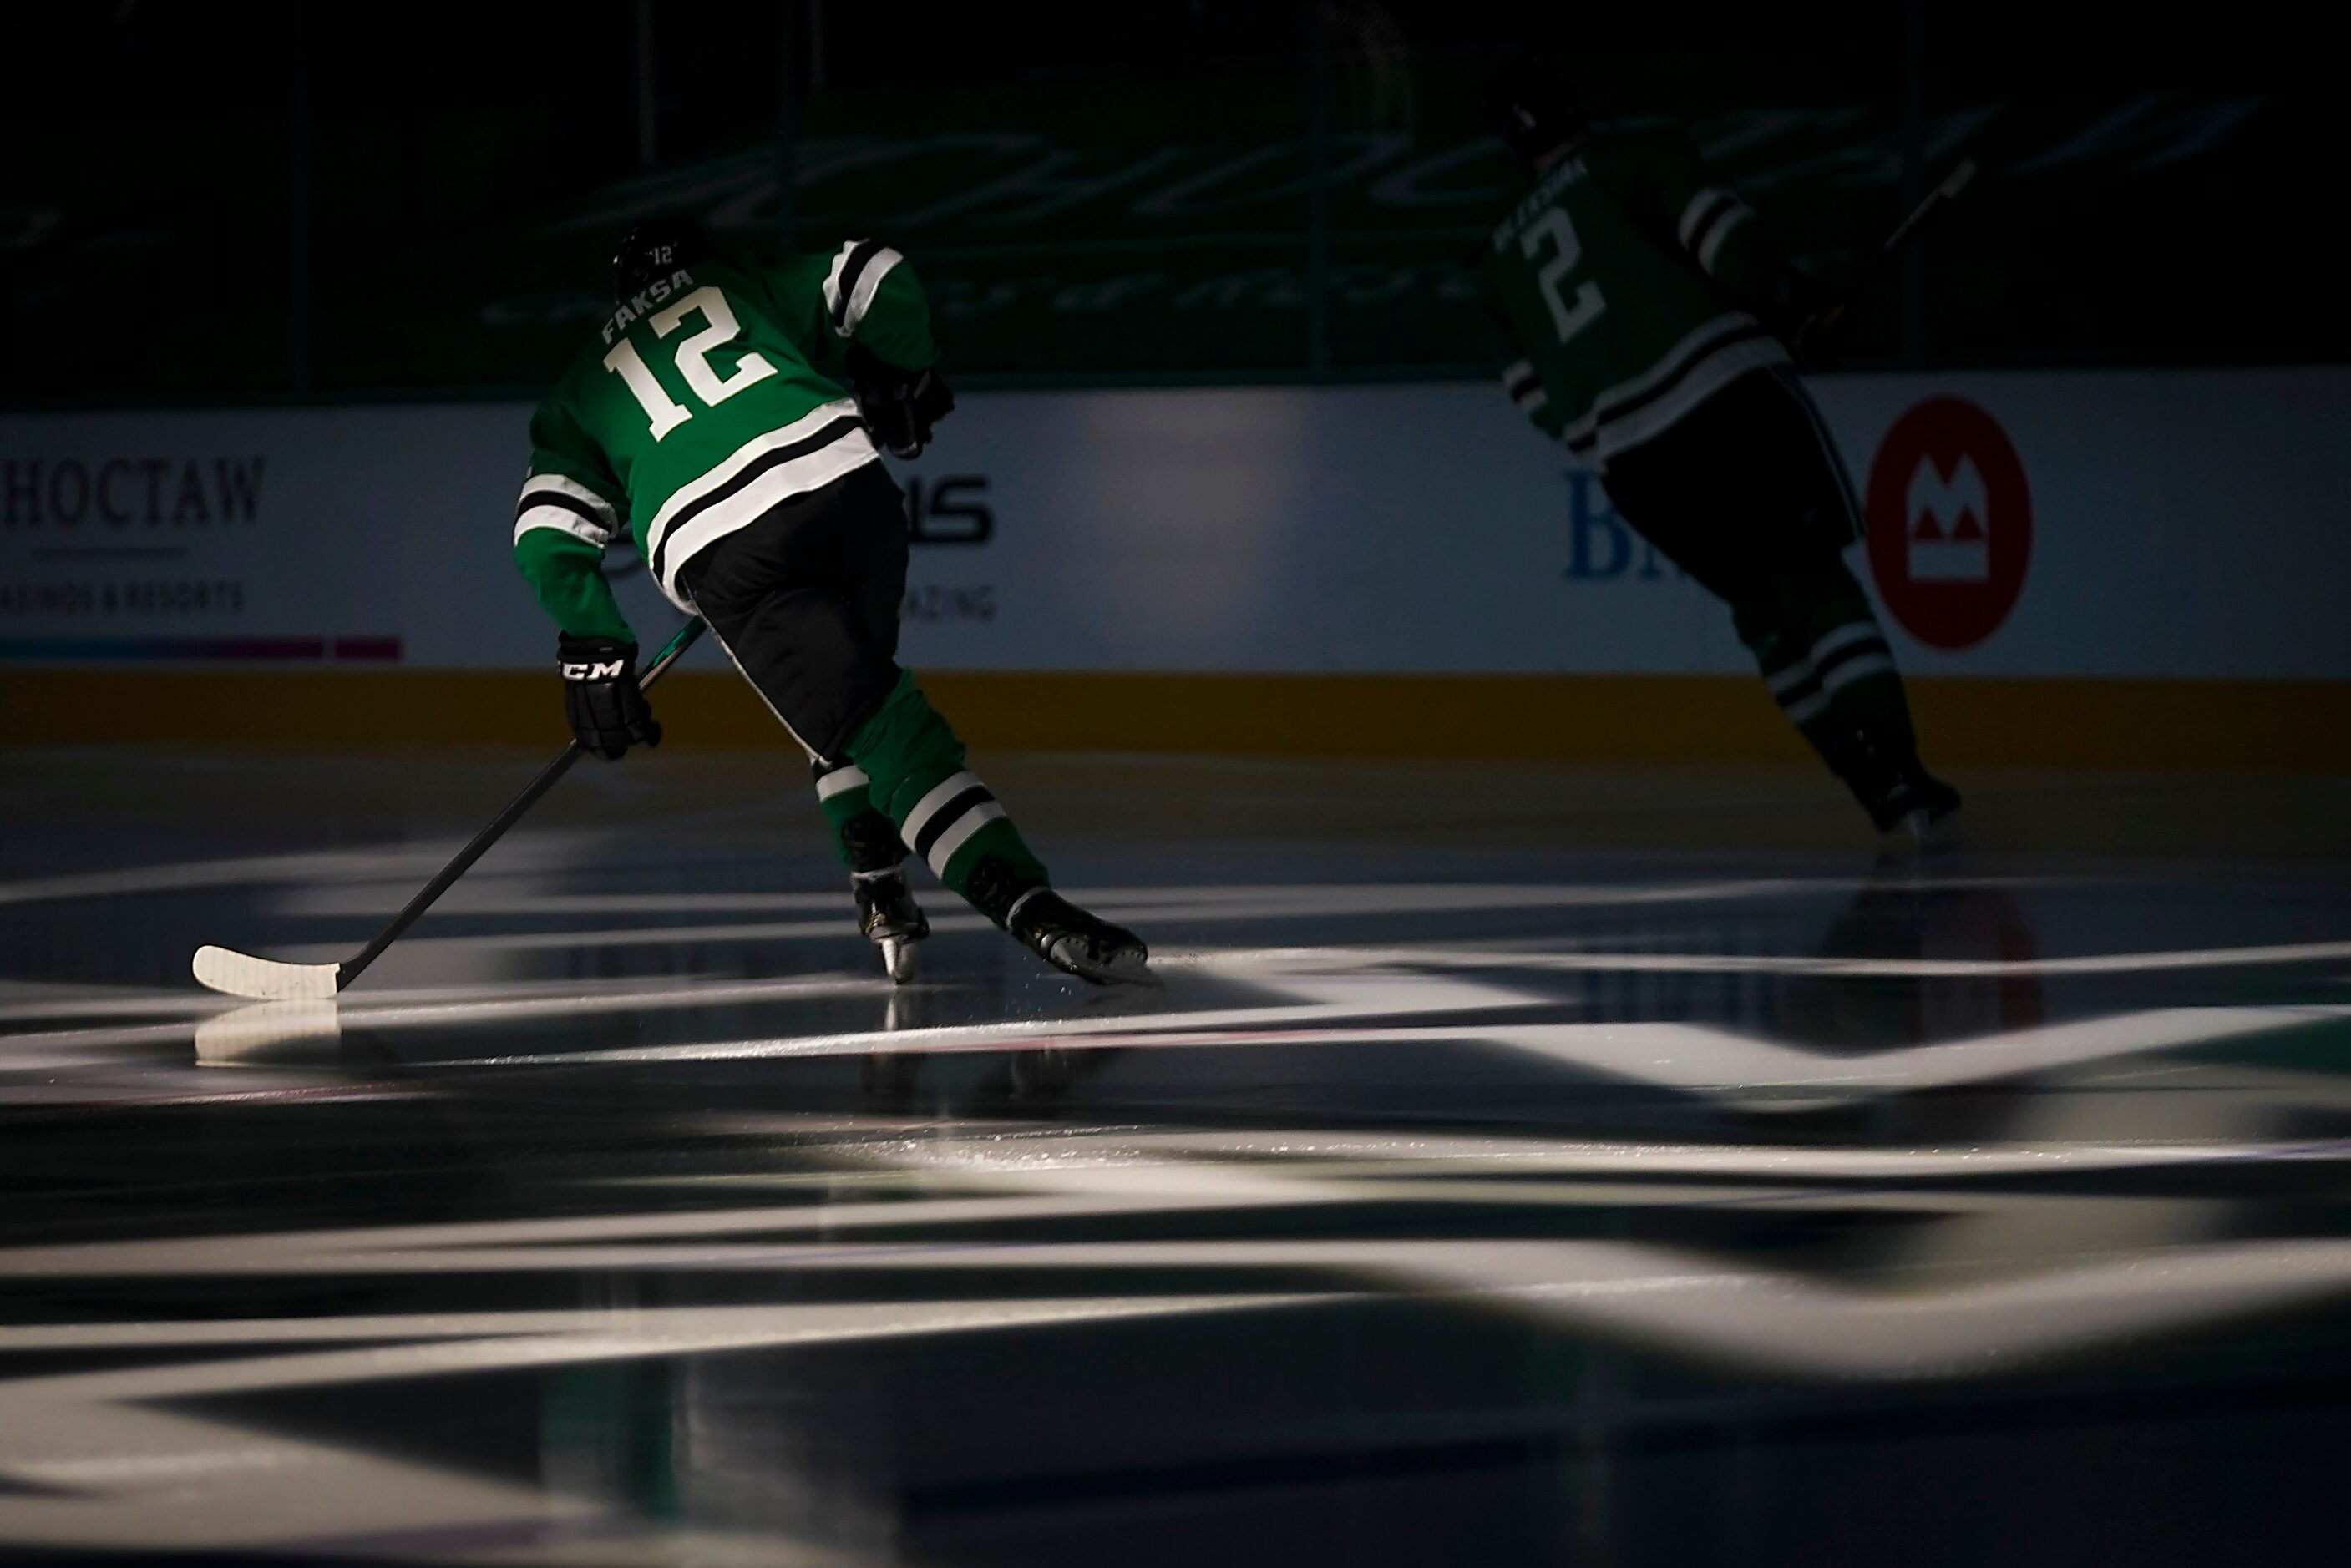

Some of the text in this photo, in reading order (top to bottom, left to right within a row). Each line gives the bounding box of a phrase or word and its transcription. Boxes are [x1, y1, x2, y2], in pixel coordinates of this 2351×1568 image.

[652, 245, 673, 266] 12
[1518, 205, 1608, 345] 2
[601, 268, 695, 345] FAKSA
[601, 284, 778, 443] 12
[0, 457, 265, 525] HOCTAW
[902, 586, 997, 620] AZING
[558, 659, 625, 680] CM
